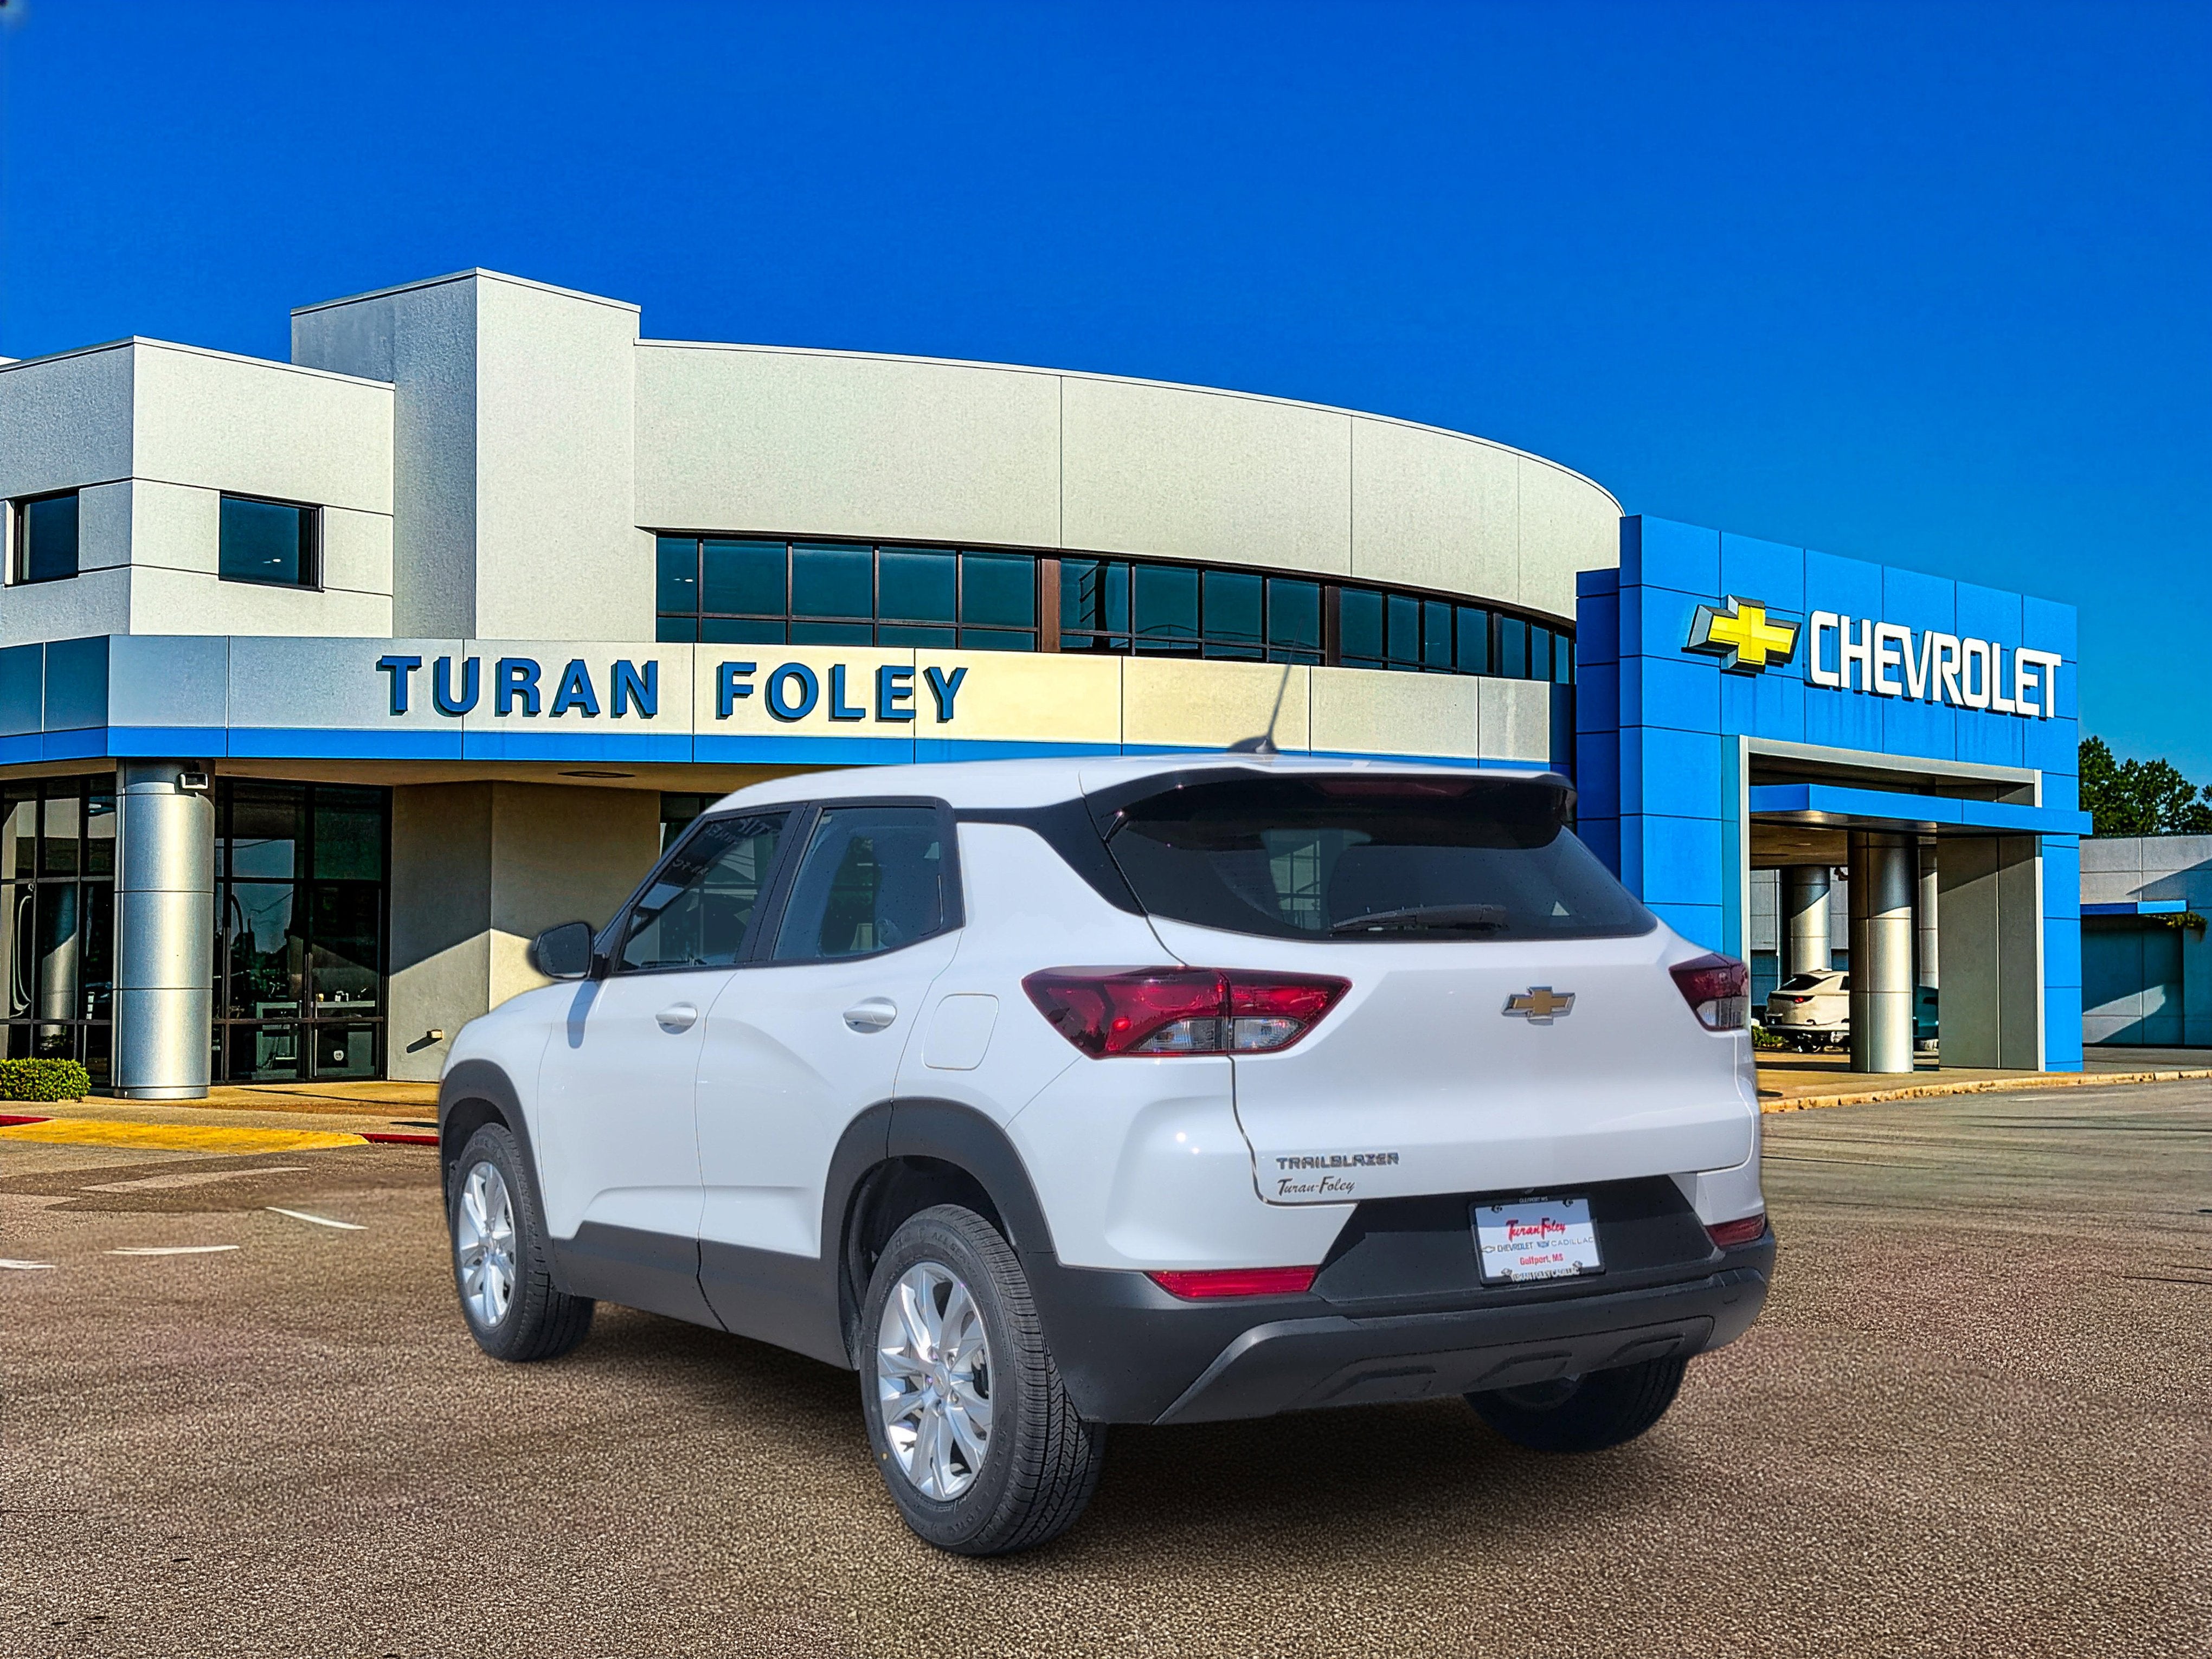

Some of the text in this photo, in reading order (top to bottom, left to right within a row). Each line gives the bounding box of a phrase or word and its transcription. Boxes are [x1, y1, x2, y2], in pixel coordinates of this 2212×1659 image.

[1809, 609, 2062, 718] CHEVROLET
[376, 655, 968, 722] TURAN FOLEY
[1276, 1152, 1399, 1169] TRAILBLAZER
[1497, 1237, 1594, 1252] CHEVROLET CADILLAC
[1520, 1253, 1564, 1266] Gulfport, MS
